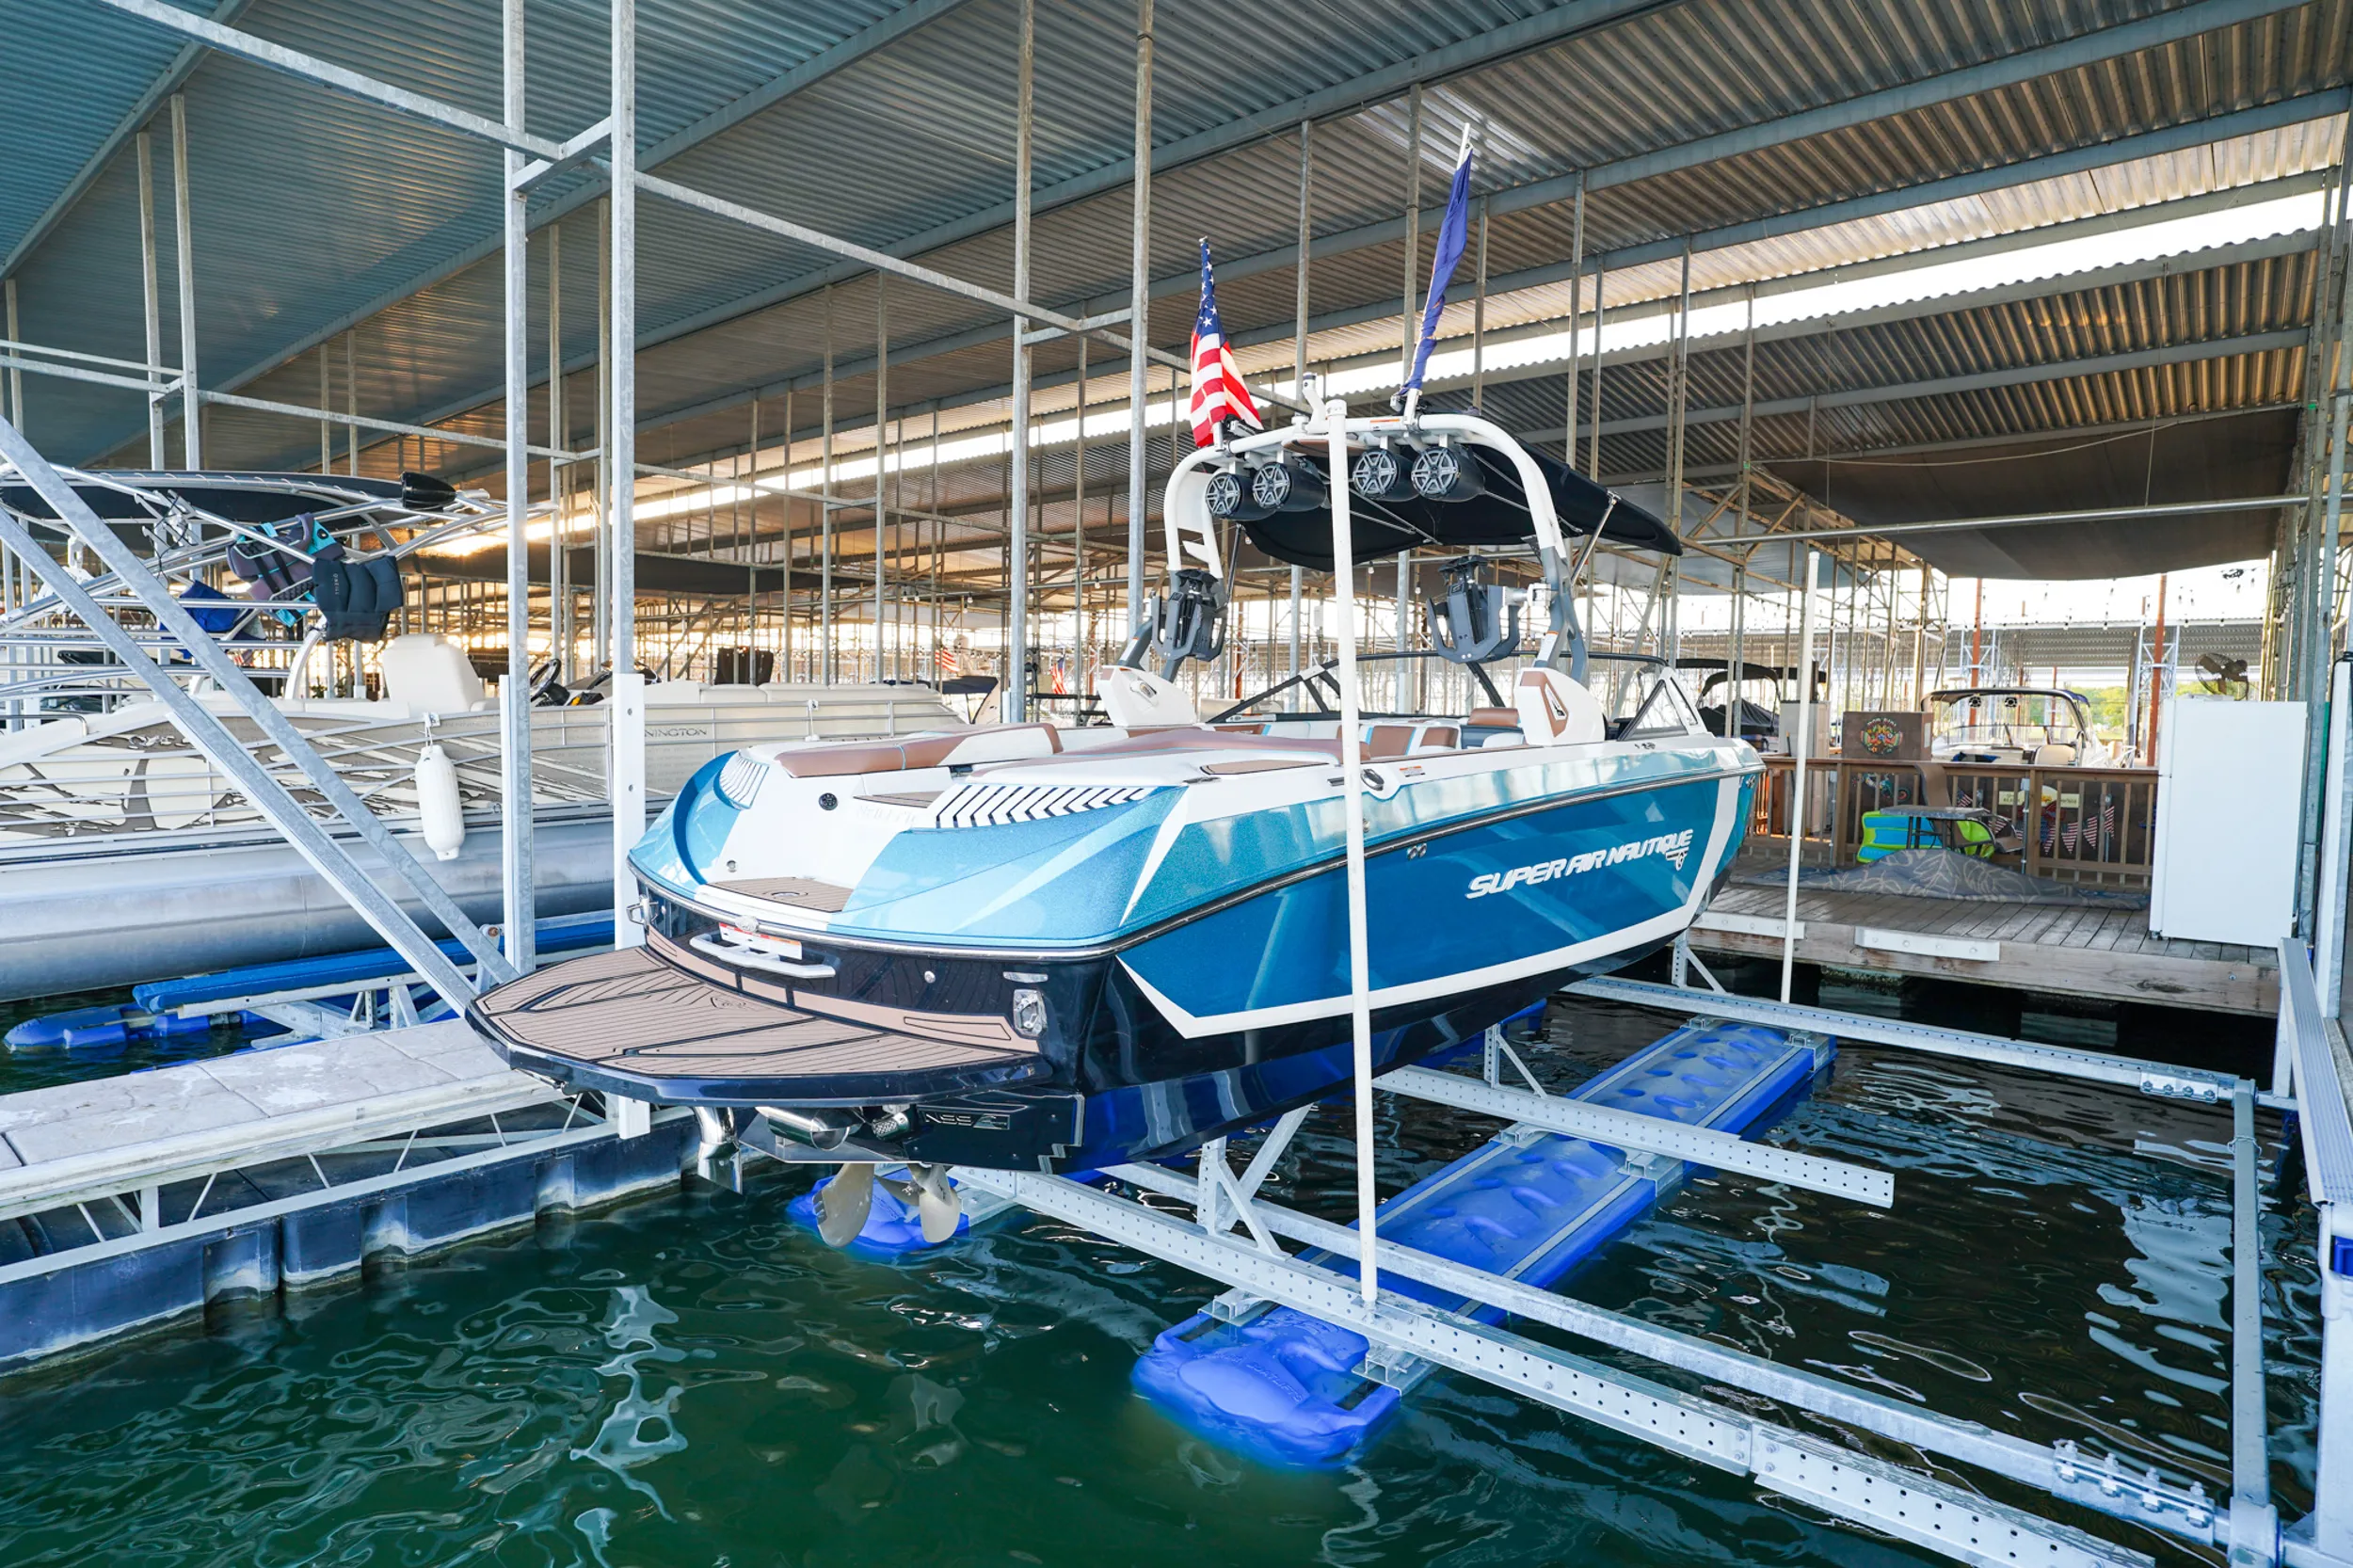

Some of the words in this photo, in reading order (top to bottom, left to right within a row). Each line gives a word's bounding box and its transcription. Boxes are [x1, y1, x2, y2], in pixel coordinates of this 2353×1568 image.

[645, 728, 707, 737] NINGTON
[1465, 857, 1567, 900] SUPER
[1564, 849, 1608, 877] AIR
[1604, 828, 1693, 867] NAUTIQUE
